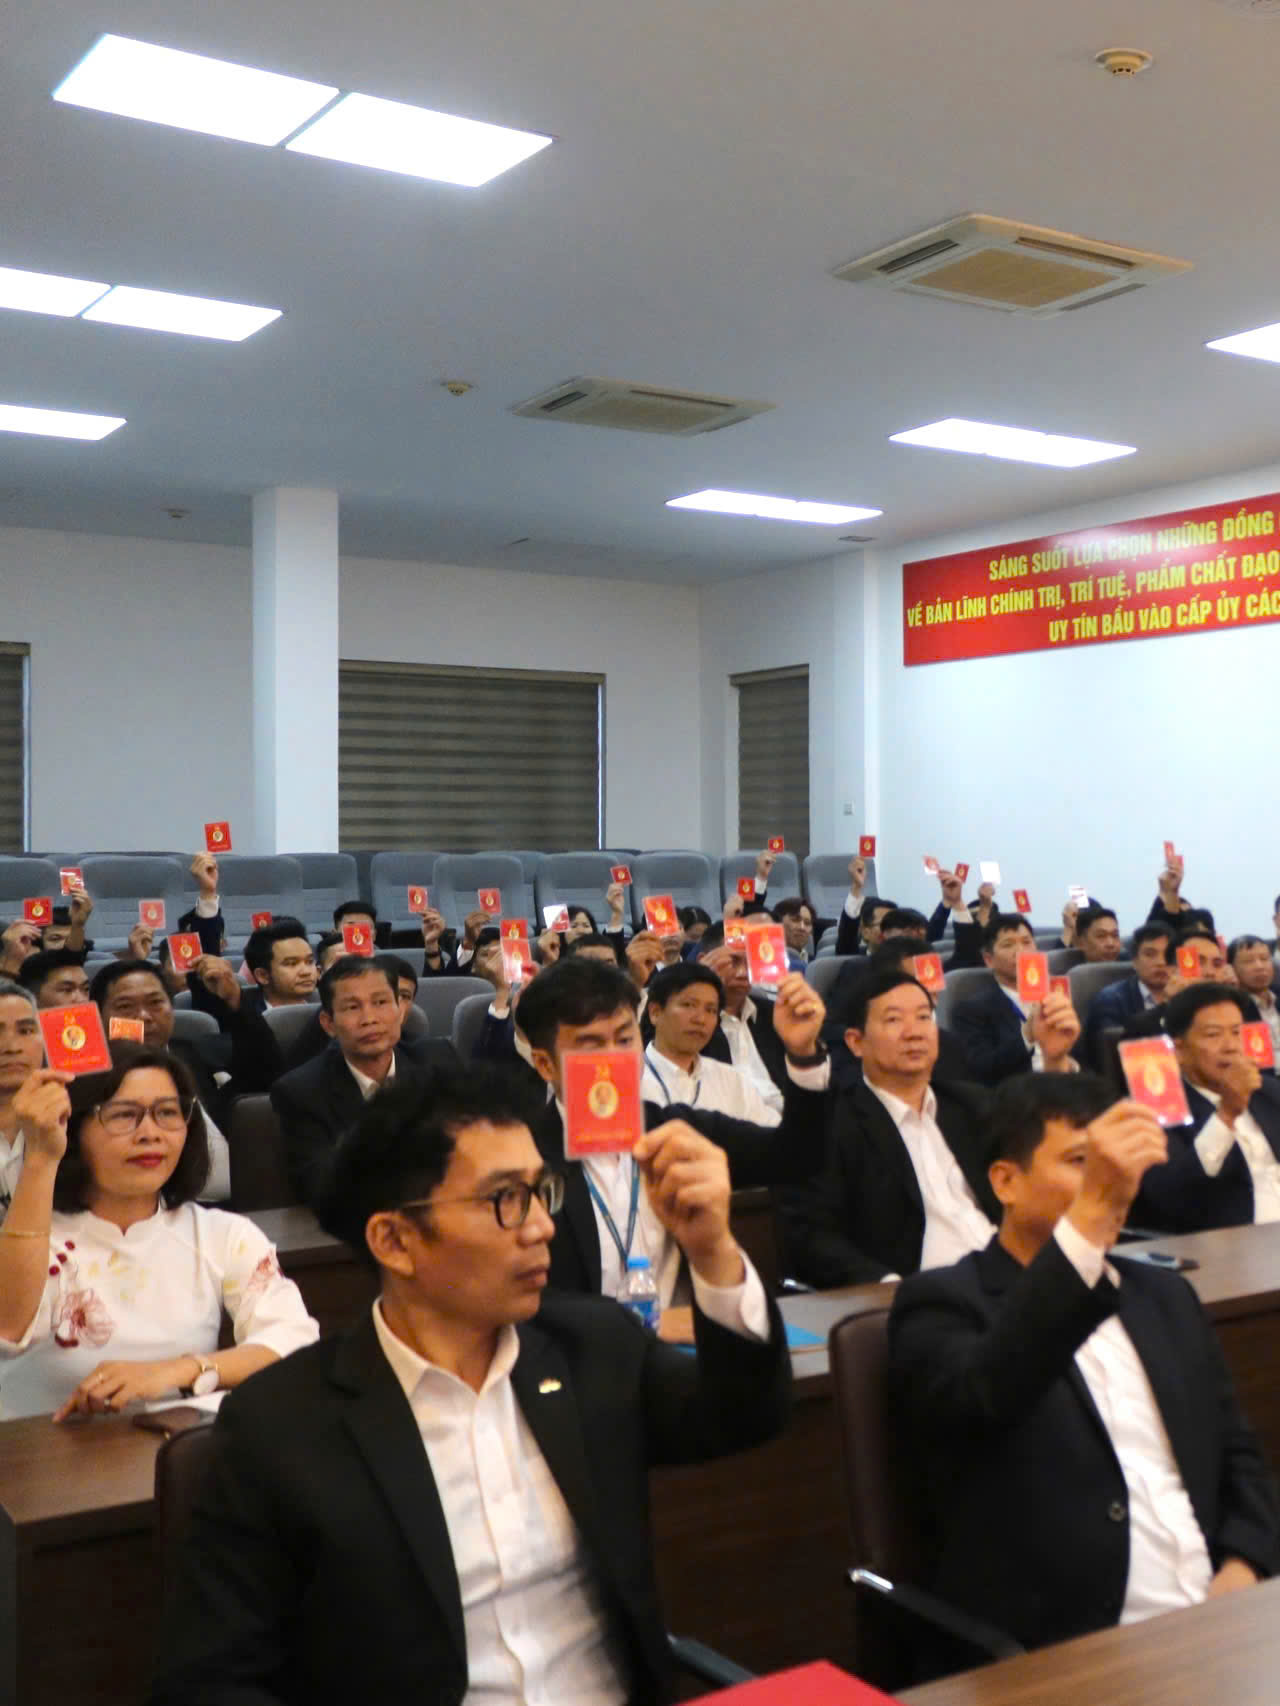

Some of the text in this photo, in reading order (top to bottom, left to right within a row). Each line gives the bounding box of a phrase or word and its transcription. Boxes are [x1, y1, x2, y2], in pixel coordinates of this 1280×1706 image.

[989, 554, 1028, 581] SÁNG
[1073, 541, 1103, 569] LỰA
[1107, 533, 1152, 561] CHỌN
[1157, 521, 1217, 551] NHỮNG
[1222, 508, 1274, 542] ĐỒNG
[925, 597, 953, 625] BẢN
[956, 595, 987, 620] LĨNH
[990, 588, 1034, 615] CHÍNH
[1070, 576, 1094, 603] TRÍ
[1191, 551, 1237, 584] CHẤT
[1242, 550, 1280, 582] ĐẠO
[1049, 618, 1069, 642] UY
[1072, 612, 1099, 639] TÍN
[1138, 603, 1172, 630] VÀO
[1176, 593, 1212, 626] CẤP
[1216, 591, 1241, 622] ỦY
